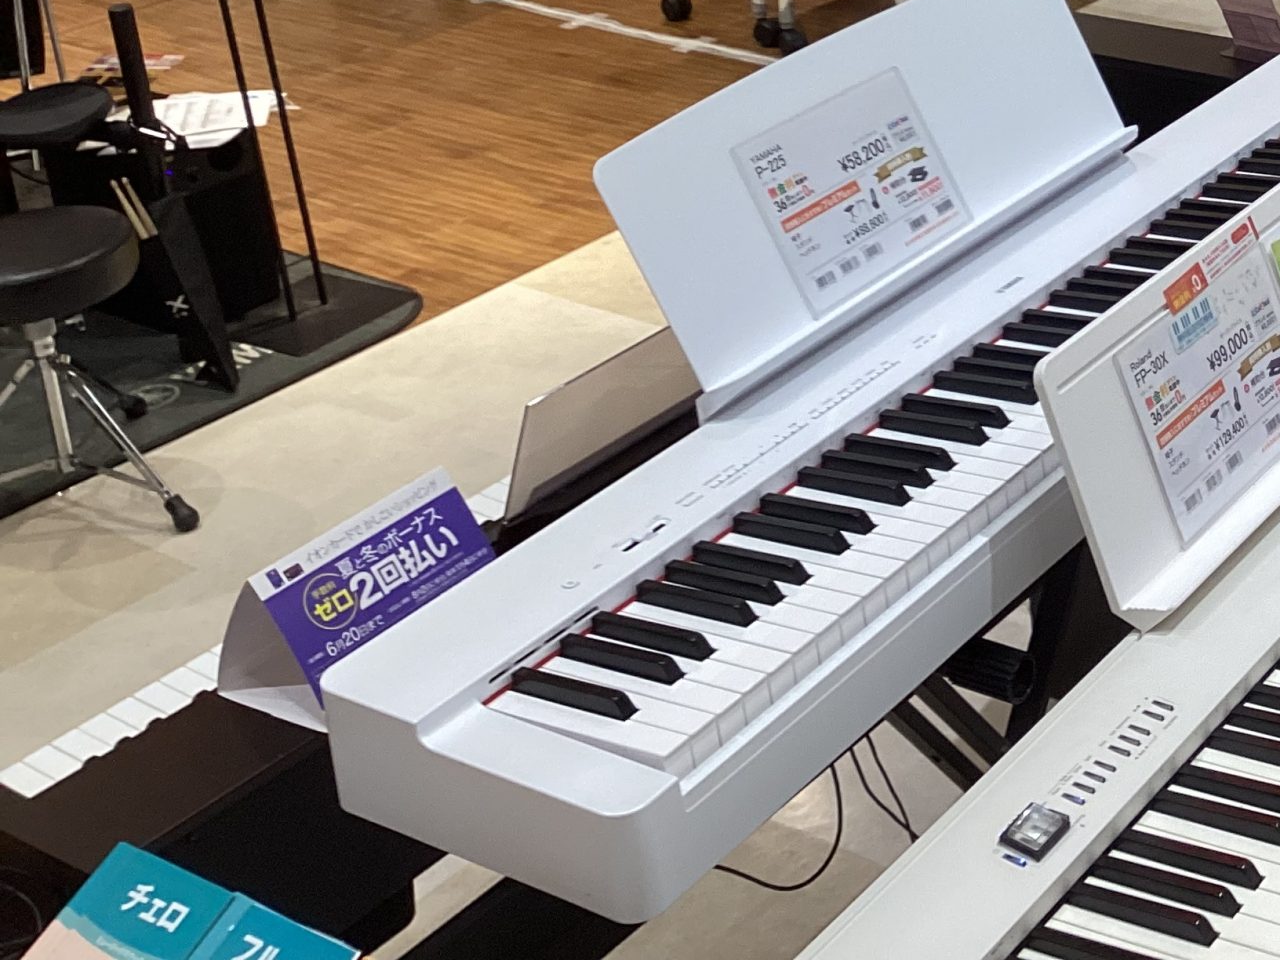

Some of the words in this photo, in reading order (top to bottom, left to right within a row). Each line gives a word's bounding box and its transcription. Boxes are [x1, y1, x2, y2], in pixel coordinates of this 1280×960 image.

[755, 154, 787, 180] P-225
[837, 138, 886, 172] ¥58,200
[1130, 348, 1153, 372] Roland
[1206, 328, 1249, 372] ¥99,000
[1134, 351, 1170, 388] FP-30X
[1150, 410, 1163, 426] 36
[335, 507, 443, 580] 夏と冬のボーナス
[350, 526, 459, 610] 2回払い
[314, 588, 354, 622] ゼロ
[326, 614, 385, 657] 6月20日まで
[120, 884, 190, 933] チェロ
